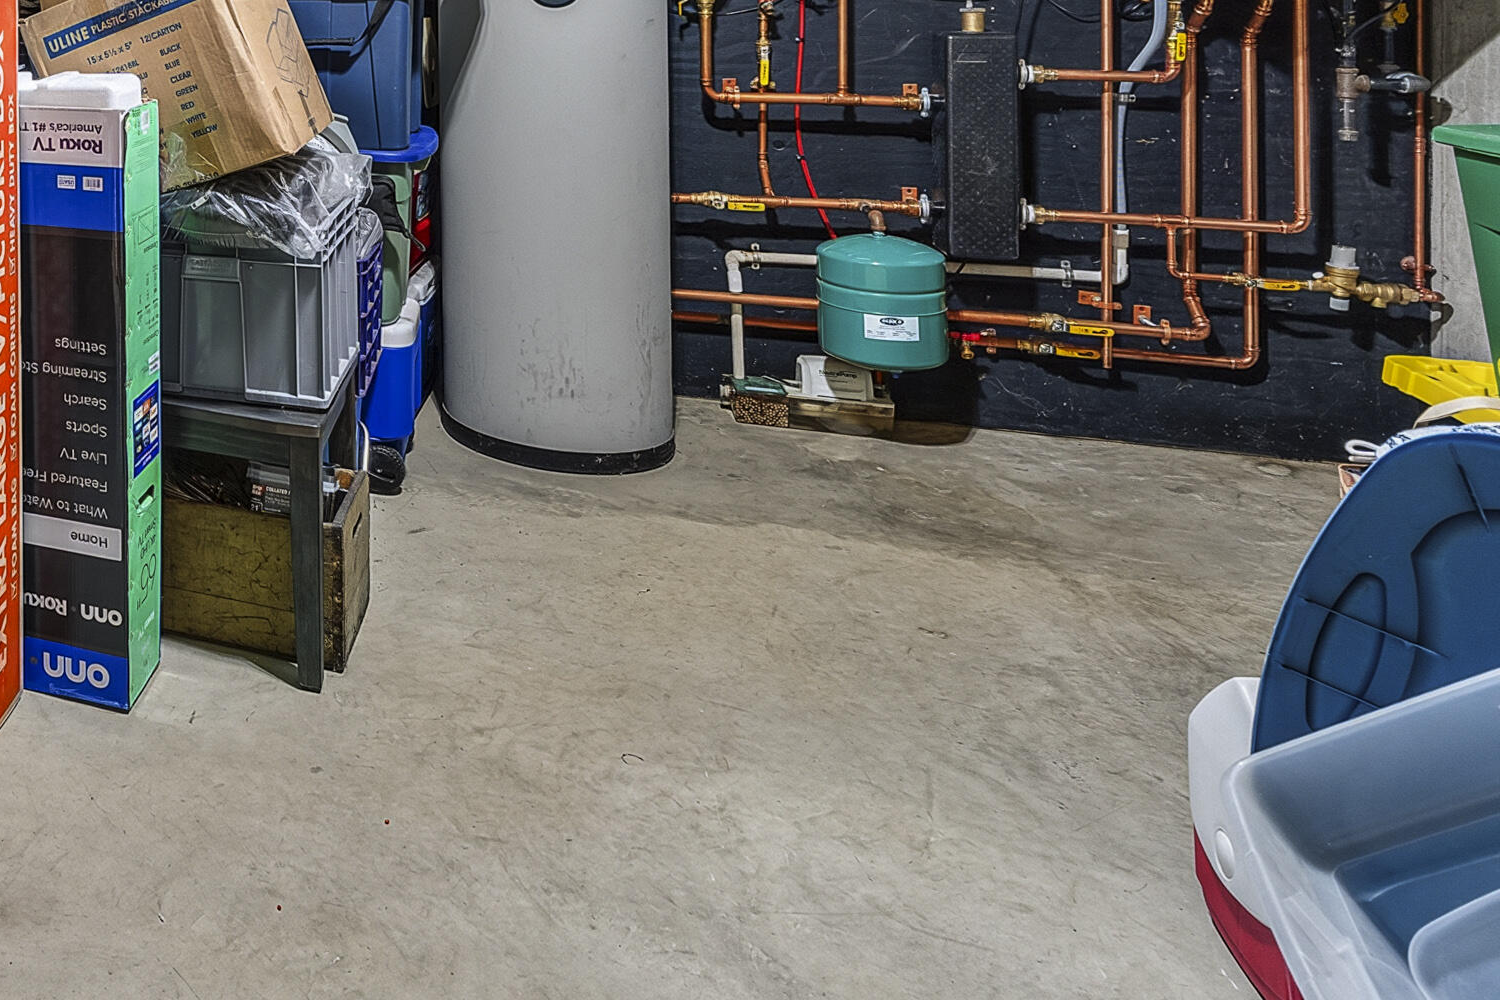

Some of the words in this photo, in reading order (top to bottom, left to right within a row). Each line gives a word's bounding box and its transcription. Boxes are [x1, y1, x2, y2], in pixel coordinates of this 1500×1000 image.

[48, 26, 90, 53] ULINE
[91, 11, 127, 35] PLASTIC
[86, 56, 97, 66] 15
[139, 22, 183, 44] 12/CARTON
[159, 43, 182, 57] BLACK
[165, 59, 181, 70] BLUE
[170, 71, 192, 84] CLEAR
[175, 84, 199, 97] GREEN
[7, 94, 15, 134] BOX
[180, 101, 195, 111] RED
[32, 122, 47, 132] #1
[185, 112, 207, 125] WHITE
[49, 122, 103, 135] America's
[191, 124, 218, 138] YELLOW
[32, 137, 56, 152] TV
[7, 140, 16, 189] DUTY
[7, 194, 17, 252] HEAVY
[8, 292, 18, 378] CORNERS
[54, 337, 108, 356] Settings
[42, 362, 108, 383] Streaming
[9, 383, 18, 438] FOAM
[63, 392, 108, 411] Search
[65, 420, 108, 438] Sports
[59, 448, 78, 461] TV
[81, 450, 108, 465] Live
[50, 472, 108, 493] Featured
[10, 478, 18, 517] BAG
[55, 500, 71, 512] to
[72, 502, 109, 520] What
[70, 531, 109, 549] Home
[10, 521, 19, 579] FOAM
[80, 603, 123, 626] onn
[42, 651, 111, 689] onn
